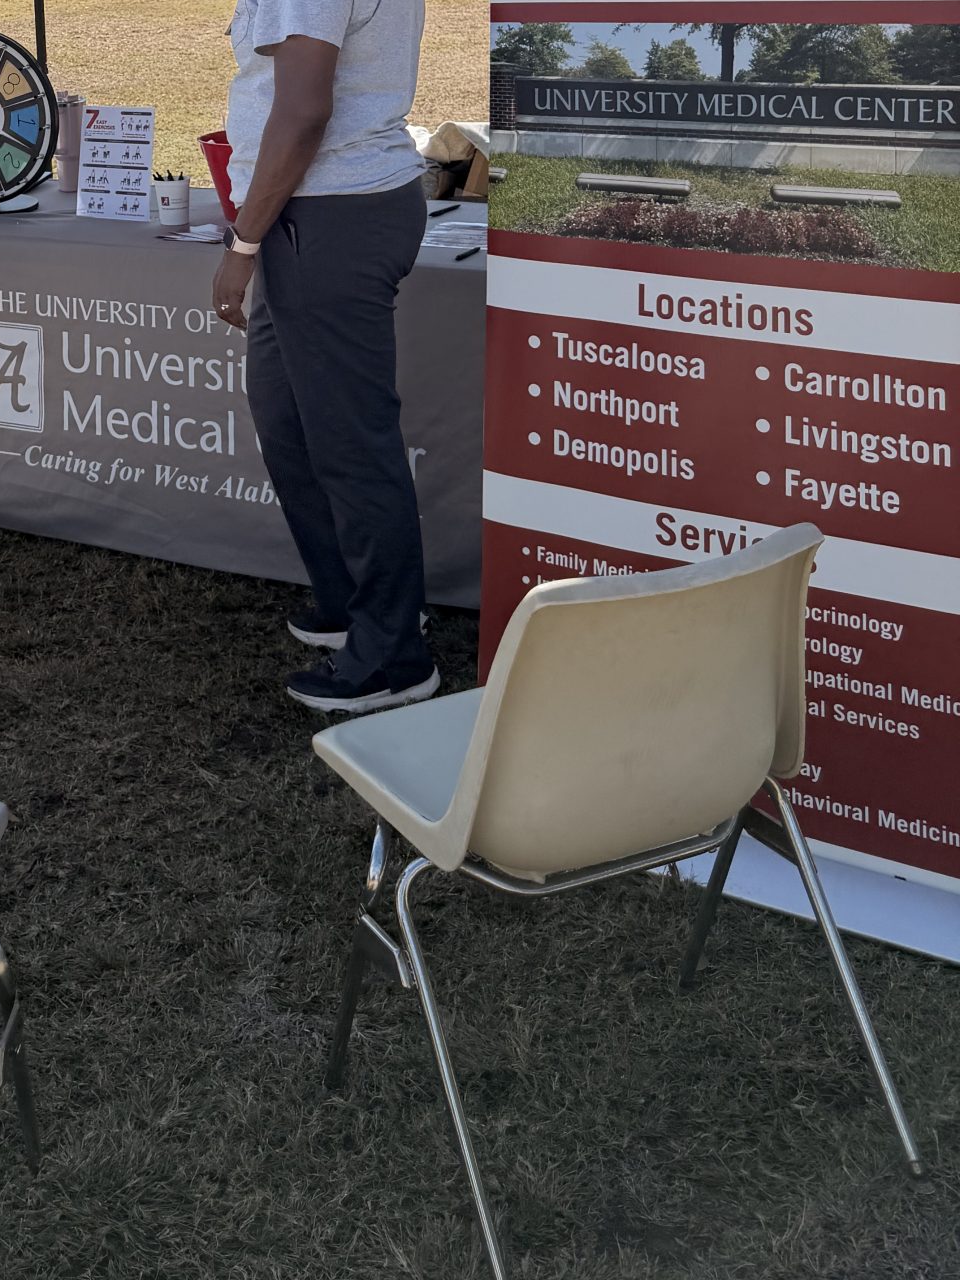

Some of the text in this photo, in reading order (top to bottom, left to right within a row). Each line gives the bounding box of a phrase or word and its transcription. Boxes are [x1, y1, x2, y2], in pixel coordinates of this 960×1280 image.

[2, 72, 21, 96] 8
[533, 87, 957, 125] UNIVERSITY MEDICAL CENTER
[17, 114, 36, 127] 1
[86, 109, 100, 129] 7
[3, 151, 21, 169] 2
[35, 293, 177, 330] UNIVERSITY
[184, 307, 218, 334] OF
[638, 283, 815, 337] Locations
[61, 330, 248, 395] Universit
[552, 331, 706, 380] Tuscaloosa
[553, 380, 680, 428] Northport
[784, 363, 947, 411] Carrollton
[62, 390, 236, 456] Medical
[785, 416, 952, 468] Livingston
[24, 444, 281, 507] Caring for West Alab
[553, 428, 695, 481] Demopolis
[785, 469, 901, 515] Fayette
[655, 512, 765, 556] Servi
[537, 545, 588, 576] Family
[805, 637, 863, 665] rology
[805, 669, 960, 717] upational Medic
[833, 703, 920, 739] Services
[878, 809, 960, 848] Medicin
